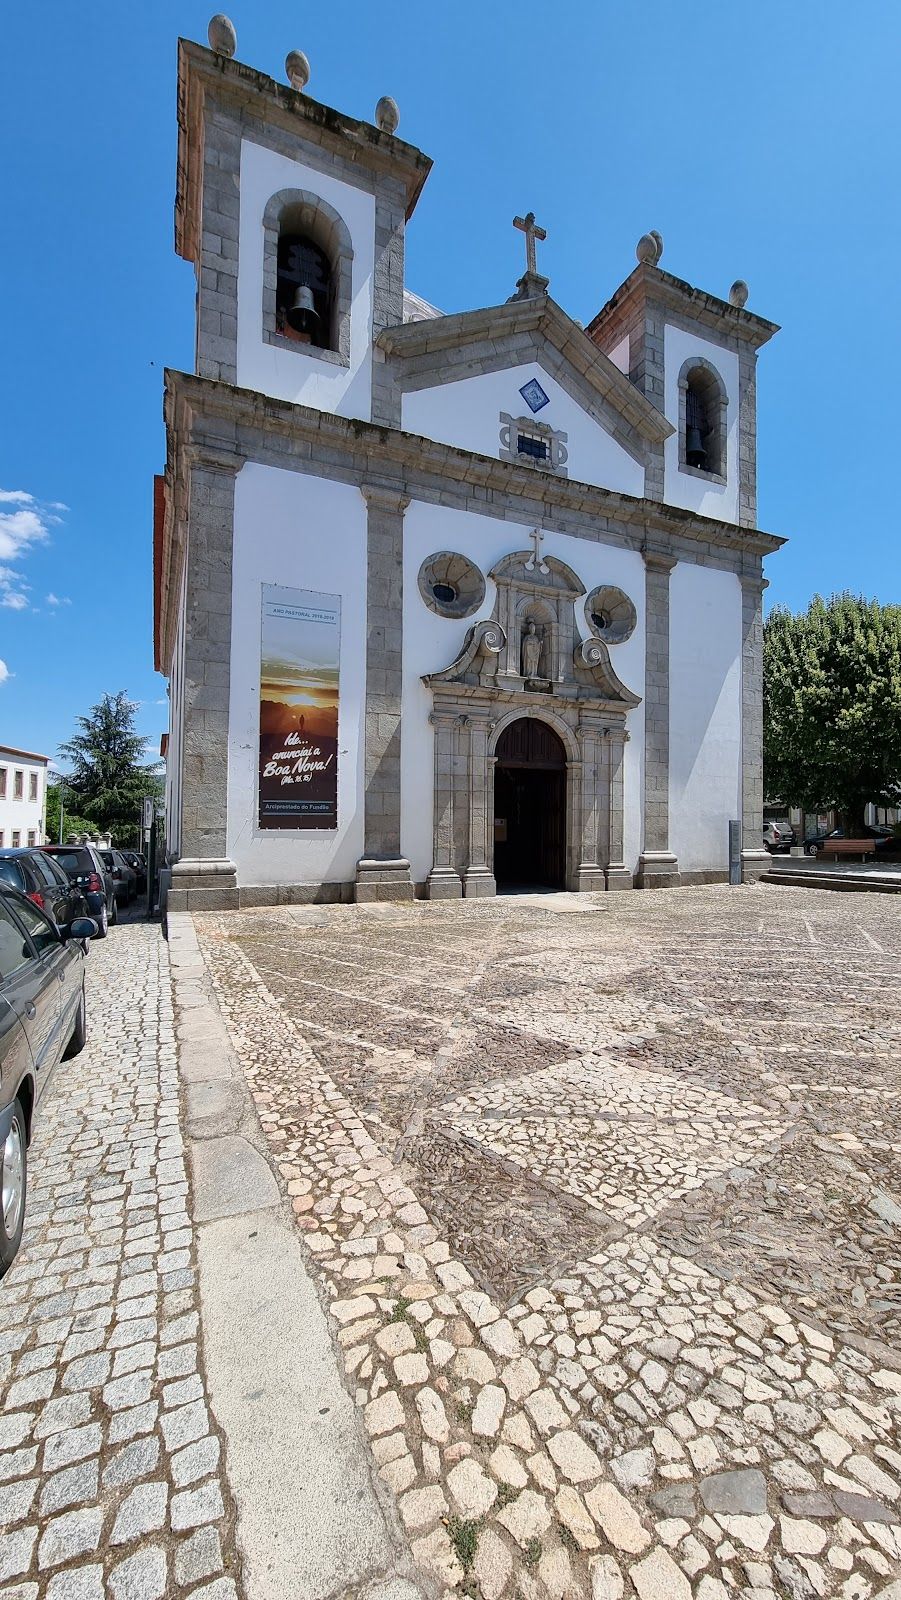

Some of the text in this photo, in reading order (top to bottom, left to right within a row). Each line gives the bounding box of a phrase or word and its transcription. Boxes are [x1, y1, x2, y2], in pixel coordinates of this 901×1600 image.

[285, 609, 311, 618] PASTORAL
[272, 746, 321, 760] anunciai a
[263, 754, 333, 777] Boa Nova!
